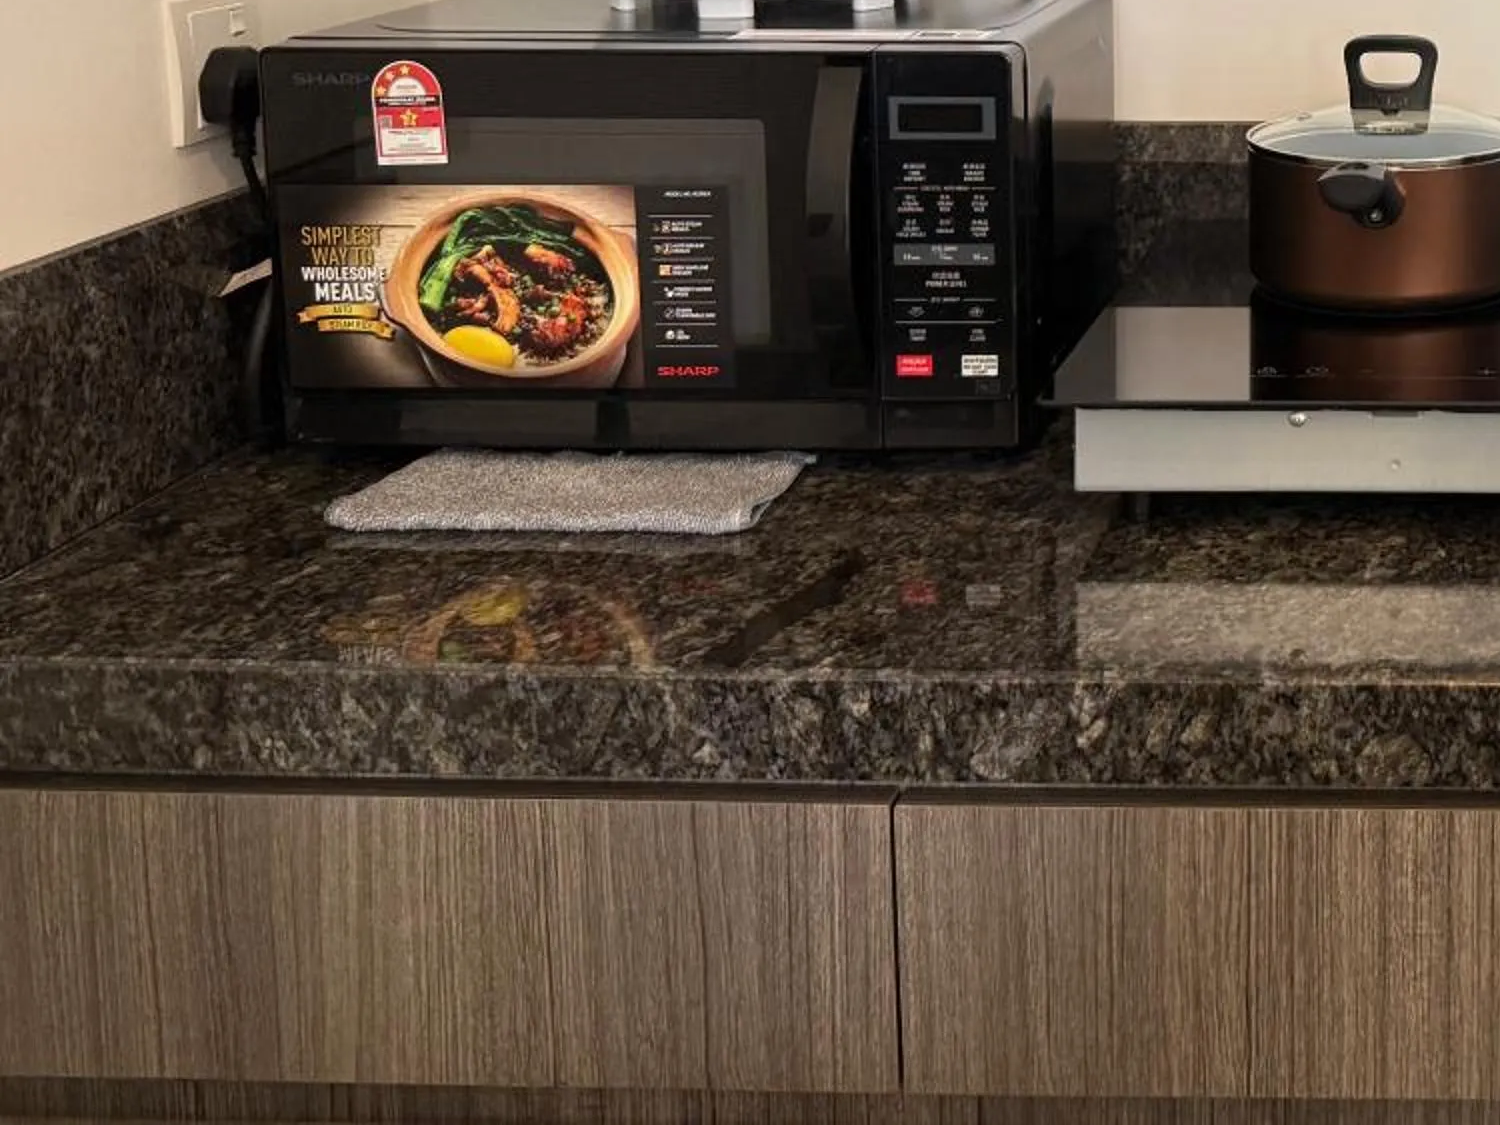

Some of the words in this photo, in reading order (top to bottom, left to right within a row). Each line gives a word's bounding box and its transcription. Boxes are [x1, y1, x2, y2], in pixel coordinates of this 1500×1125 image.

[301, 226, 383, 246] SIMPLEST
[311, 246, 348, 265] WAY
[352, 246, 375, 265] TO
[301, 266, 387, 282] WHOLESOME
[315, 282, 376, 301] MEALS
[657, 365, 721, 376] SHARP
